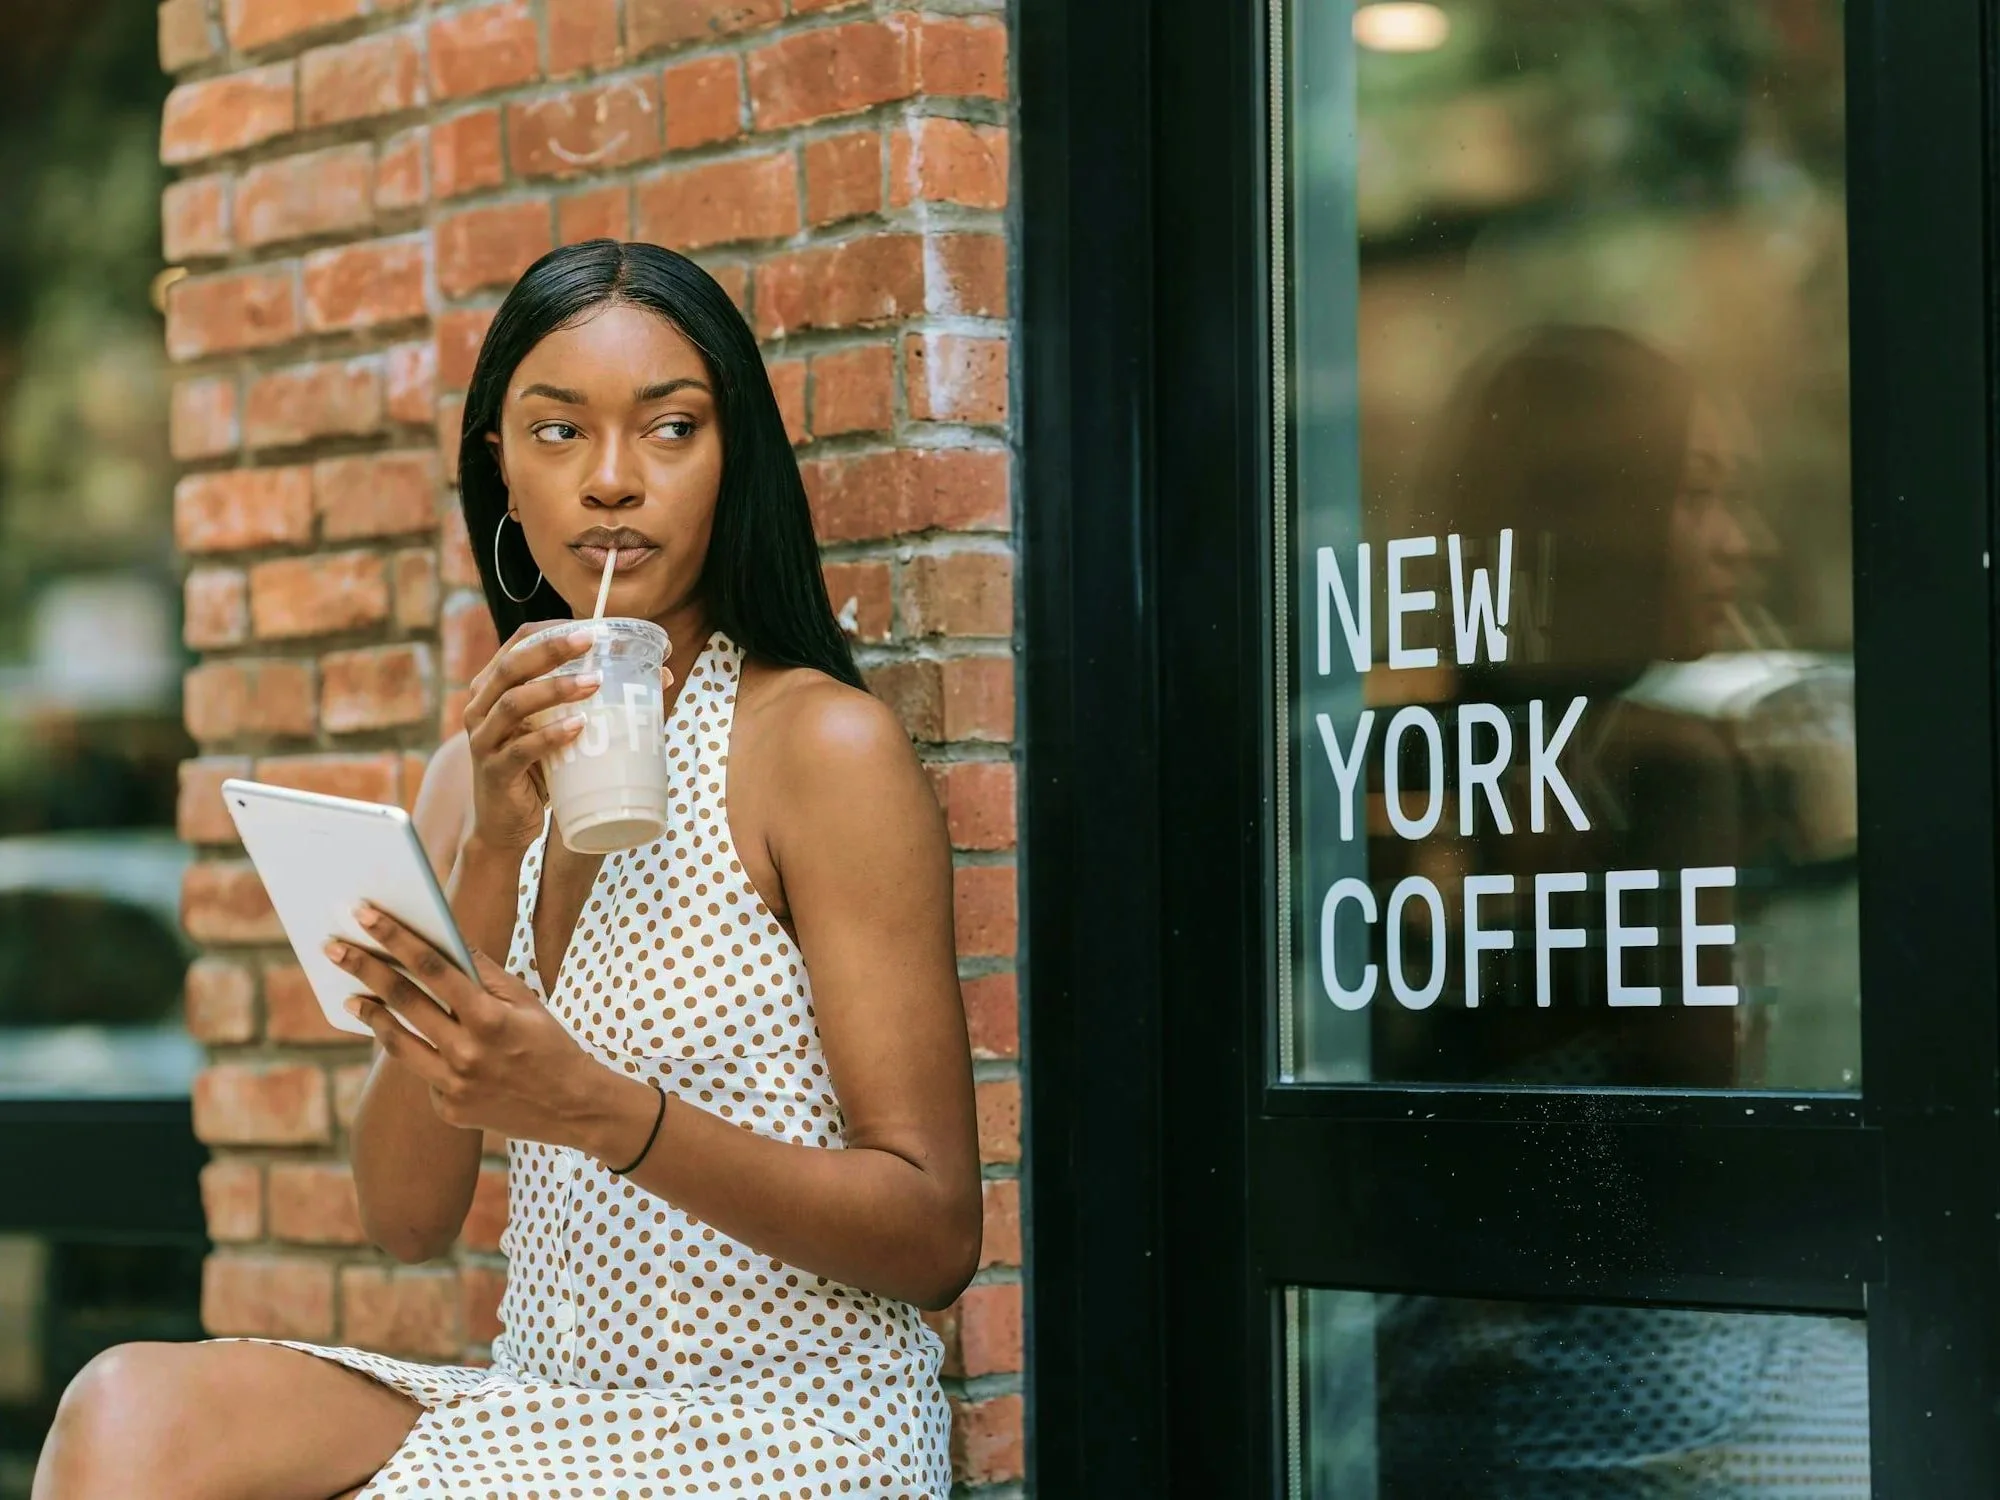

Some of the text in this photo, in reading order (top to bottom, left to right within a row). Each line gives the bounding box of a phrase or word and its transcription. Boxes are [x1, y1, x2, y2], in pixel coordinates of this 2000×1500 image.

[1317, 528, 1513, 675] NEW
[1316, 696, 1591, 841] YORK
[1321, 866, 1739, 1011] COFFEE
